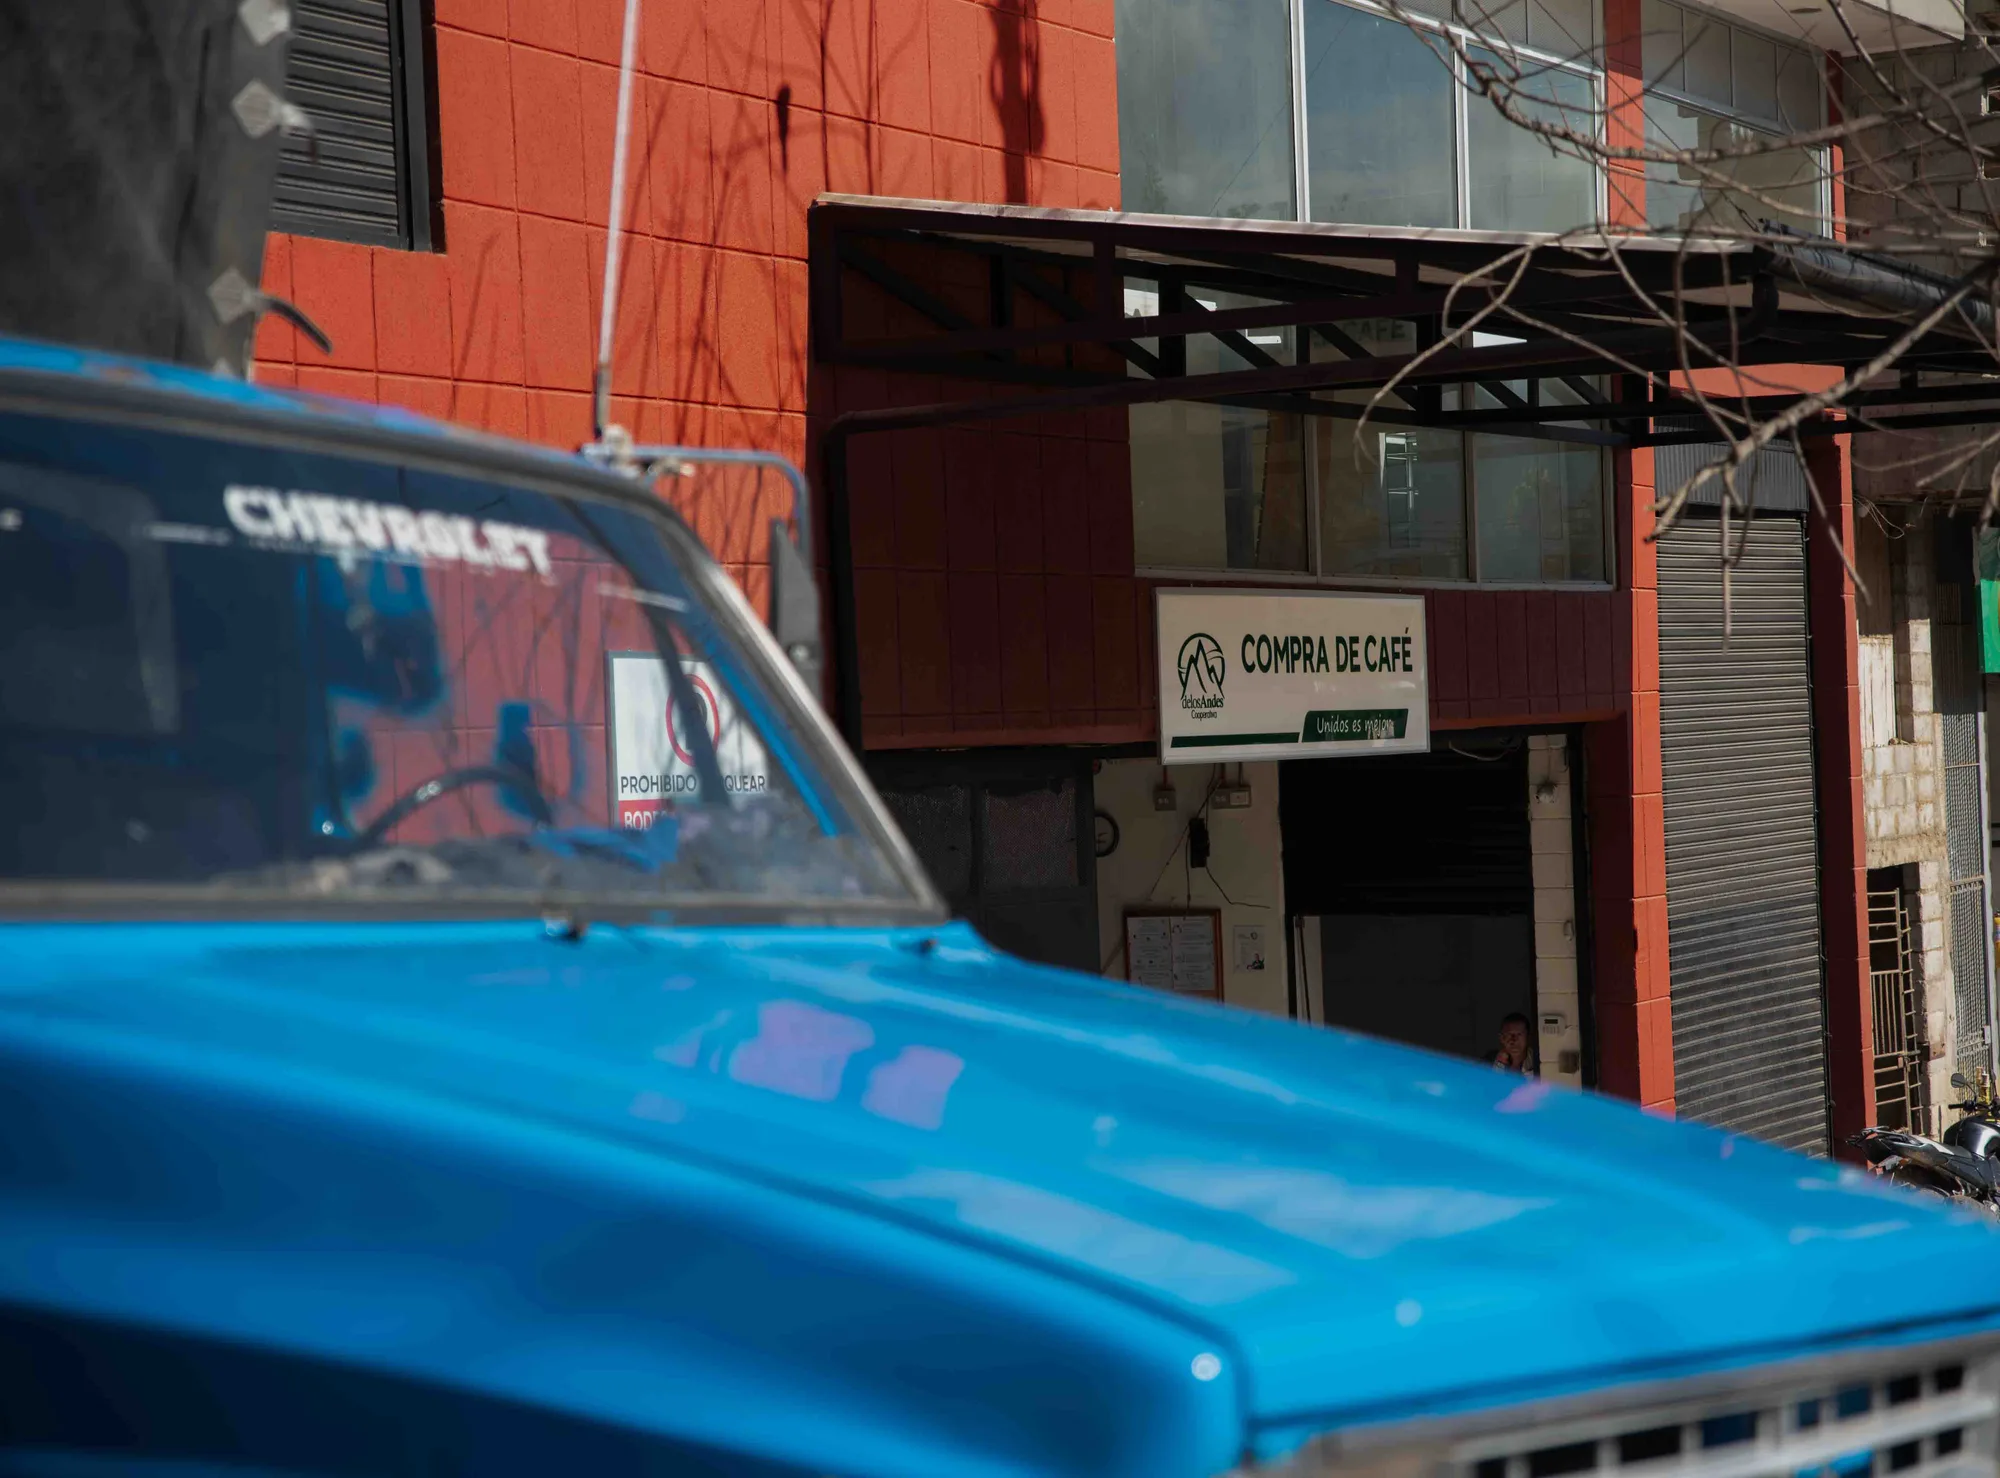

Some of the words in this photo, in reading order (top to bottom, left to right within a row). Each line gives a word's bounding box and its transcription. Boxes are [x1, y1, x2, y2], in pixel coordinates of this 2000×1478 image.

[223, 484, 551, 576] CHEVROLET
[1241, 633, 1330, 674] COMPRA
[1335, 635, 1361, 673] DE
[1364, 626, 1413, 673] CAFÉ
[1191, 709, 1218, 721] Cooperativa
[1316, 714, 1349, 734] Unidos
[1352, 719, 1361, 733] es
[620, 774, 697, 794] PROHIBIDO
[722, 774, 766, 792] QUEAR
